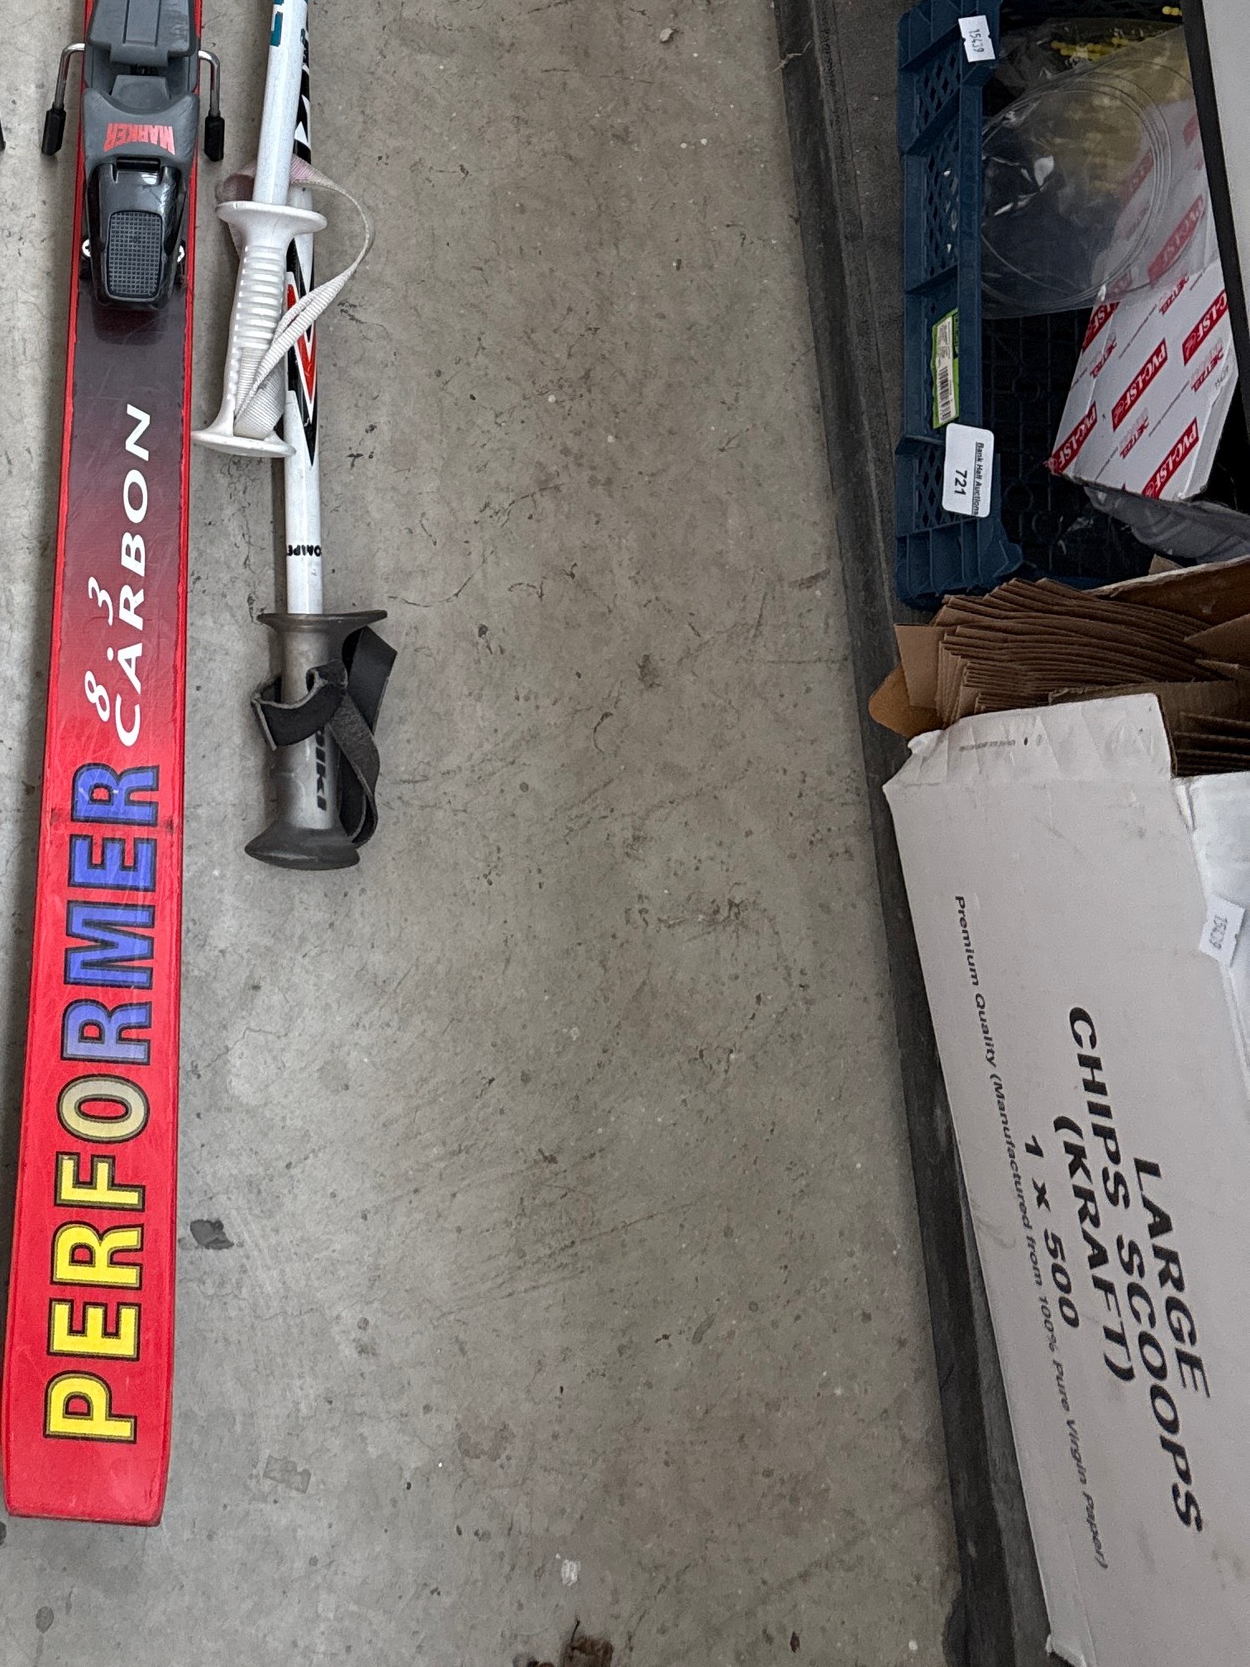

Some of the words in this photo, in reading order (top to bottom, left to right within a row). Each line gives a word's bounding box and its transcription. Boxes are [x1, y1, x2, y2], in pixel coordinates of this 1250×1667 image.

[103, 121, 176, 155] MARKER
[1123, 343, 1168, 411] PVC-LSF
[954, 469, 968, 496] 721
[972, 481, 982, 515] Auctions
[975, 464, 984, 480] Hall
[976, 442, 985, 462] Bank
[1152, 421, 1200, 491] PVC-LSF
[115, 403, 151, 747] CARBON
[42, 762, 160, 1445] PERFORMER
[955, 895, 979, 987] Premium
[975, 992, 996, 1069] Quality
[990, 1073, 1033, 1231] (Manufactured
[1026, 1235, 1043, 1287] from
[1053, 1359, 1070, 1413] Pure
[1067, 1419, 1087, 1485] Virgin
[1083, 1491, 1109, 1569] Paper)
[1025, 1135, 1044, 1158] 1
[1044, 1229, 1079, 1328] 500
[1053, 1116, 1136, 1382] (KRAFT)
[1069, 1007, 1130, 1209] CHIPS
[1117, 1234, 1203, 1532] SCOOPS
[1133, 1157, 1210, 1399] LARGE
